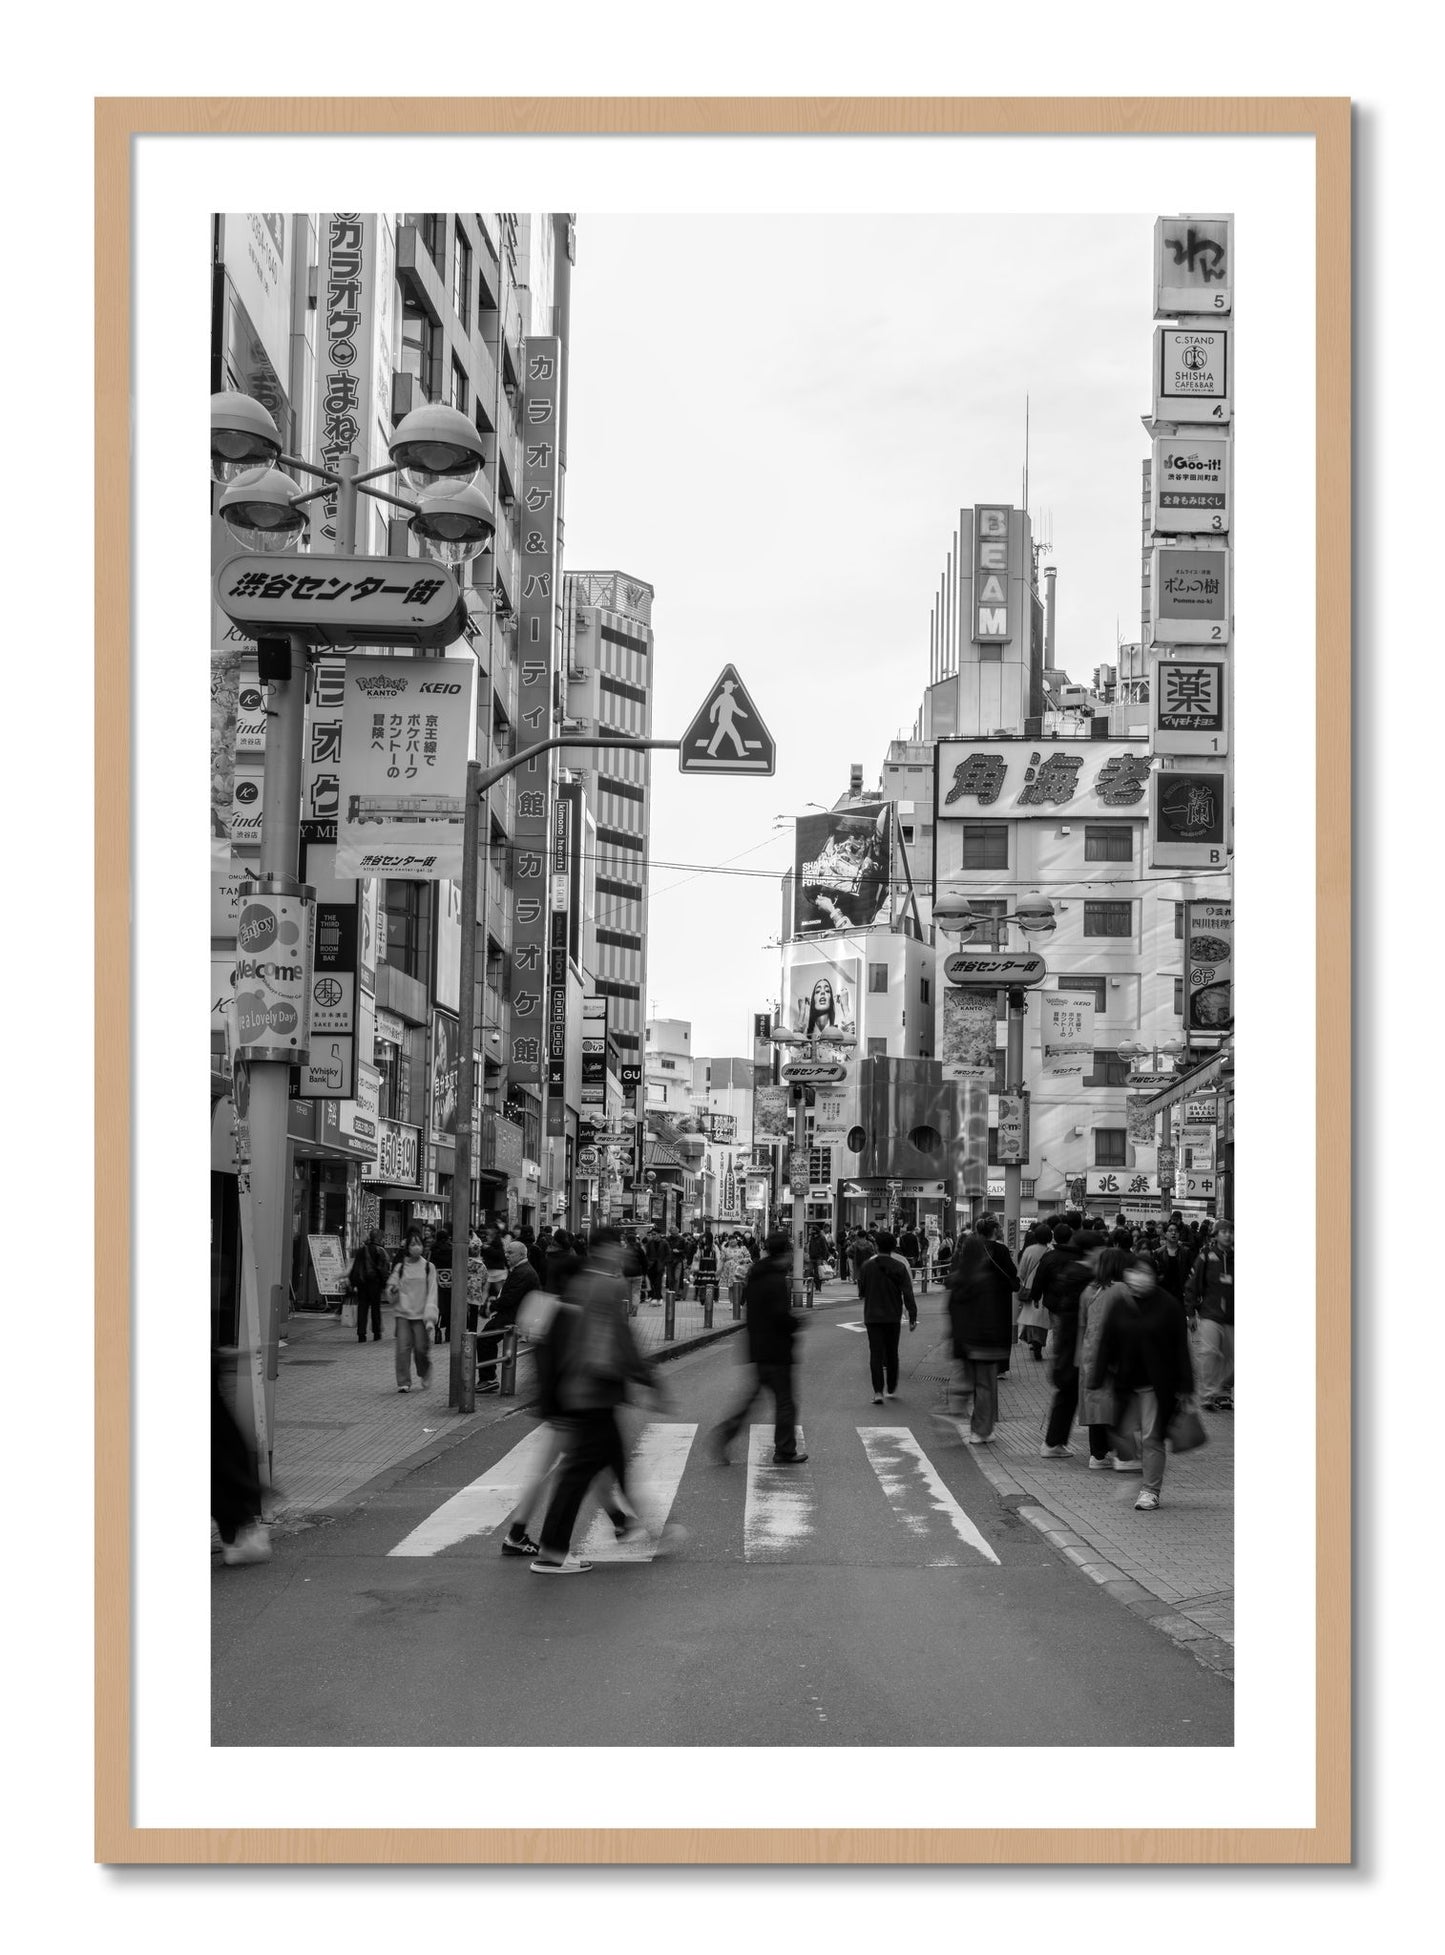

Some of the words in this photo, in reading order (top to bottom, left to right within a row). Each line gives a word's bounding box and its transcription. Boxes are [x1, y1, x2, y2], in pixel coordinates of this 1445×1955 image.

[327, 221, 363, 341] カラオケ
[1214, 295, 1225, 308] 5
[1175, 336, 1214, 344] C.STAND
[1175, 372, 1214, 380] SHISHA
[321, 370, 360, 541] まねき
[1174, 456, 1221, 470] Goo-it!
[1163, 495, 1223, 506] 全身もみほぐし
[1212, 516, 1222, 529] 3
[979, 509, 1007, 635] BEAM
[228, 571, 445, 605] 渋谷センター街
[1164, 578, 1219, 594] ポムの樹
[1211, 626, 1222, 640] 2
[419, 682, 462, 695] KEIO
[1167, 669, 1211, 712] 薬
[1162, 715, 1215, 728] マツモトキヨシ
[371, 713, 385, 751] 冒険へ
[387, 713, 403, 778] カントーの
[405, 713, 421, 778] ポケパーク
[423, 714, 439, 766] 京王線で
[1211, 738, 1218, 751] 1
[945, 752, 1151, 804] 角海老
[1162, 786, 1214, 828] 一蘭
[557, 804, 566, 835] kimono
[360, 855, 437, 867] 渋谷センター街
[1210, 850, 1219, 863] B
[240, 917, 274, 945] Enjoy
[1192, 918, 1230, 930] 四川料理
[320, 945, 339, 953] ROOM
[512, 852, 544, 1065] カラオケ館
[951, 961, 1038, 972] 渋谷センター街
[1190, 968, 1215, 985] 6F
[251, 1009, 277, 1027] Lovely
[279, 1010, 296, 1023] Day!
[310, 1067, 338, 1077] Whisky
[623, 1070, 641, 1080] GU
[784, 1067, 838, 1076] 渋谷センター街
[309, 1075, 326, 1083] Bank
[1099, 1174, 1150, 1193] 兆楽
